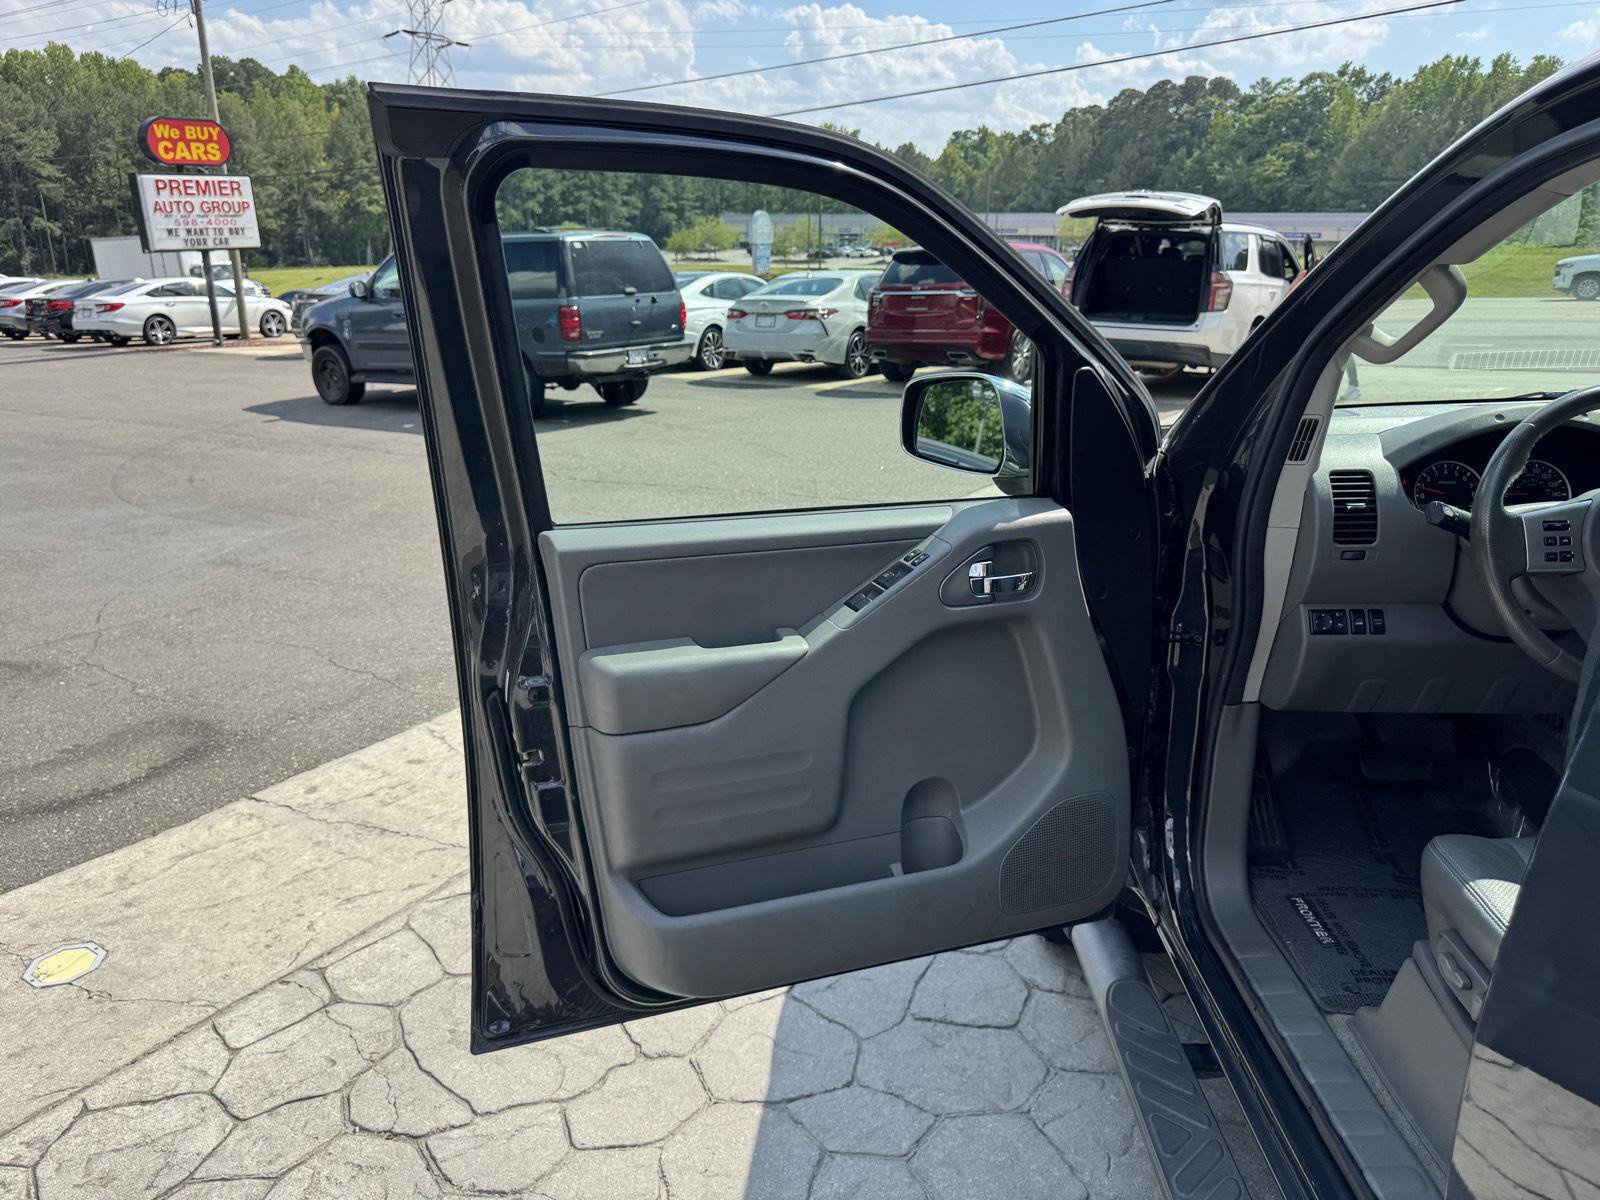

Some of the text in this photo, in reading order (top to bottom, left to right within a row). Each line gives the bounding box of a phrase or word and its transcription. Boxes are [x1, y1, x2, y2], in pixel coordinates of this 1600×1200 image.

[152, 123, 220, 141] We BUY
[157, 140, 222, 161] CARS
[154, 179, 242, 196] PREMIER
[153, 200, 250, 214] AUTO GROUP
[166, 227, 246, 237] WE WANT TO BUY
[183, 238, 230, 247] YOUR CAR
[1290, 897, 1335, 945] FRONTIER
